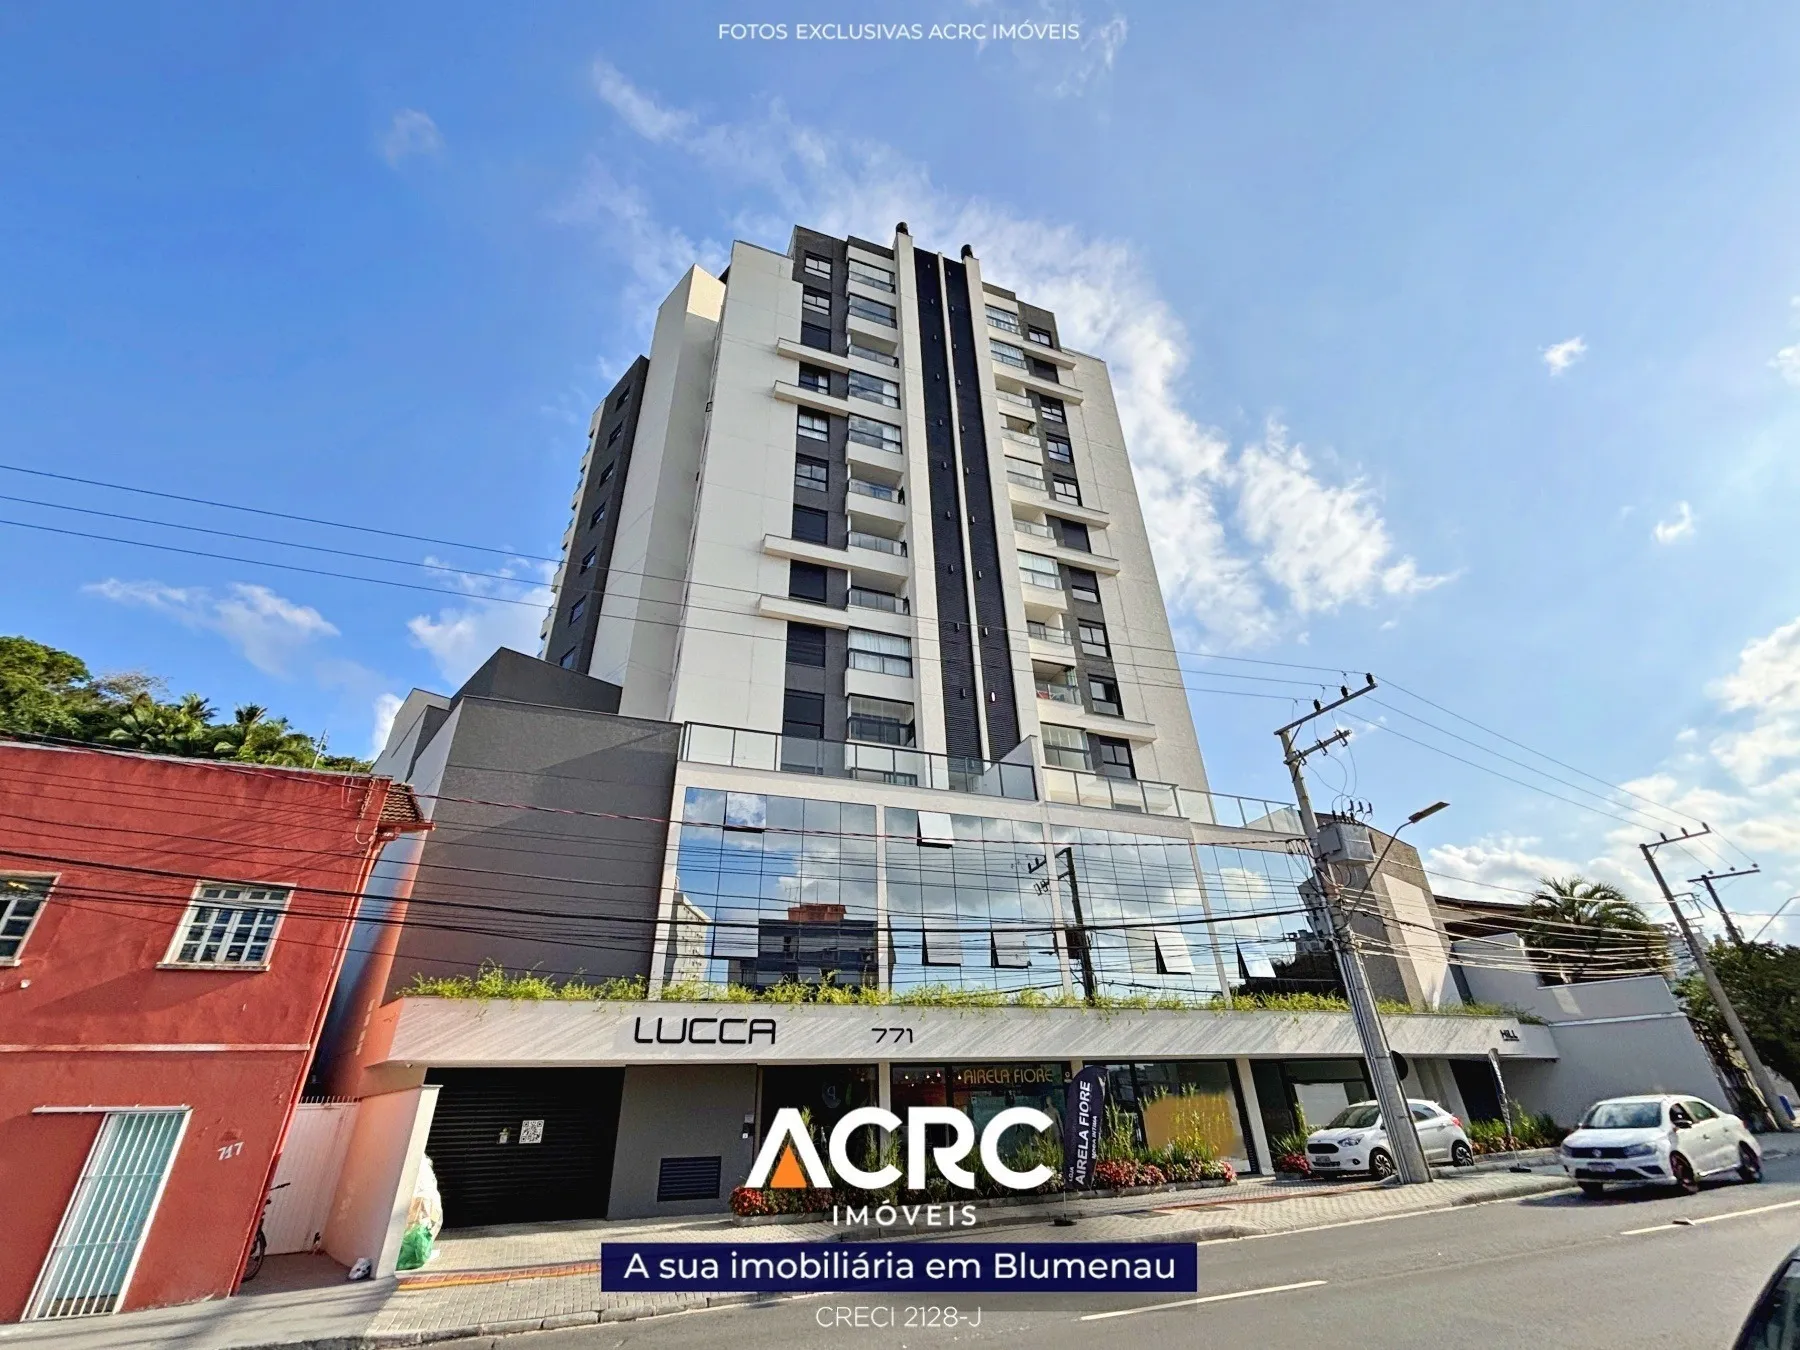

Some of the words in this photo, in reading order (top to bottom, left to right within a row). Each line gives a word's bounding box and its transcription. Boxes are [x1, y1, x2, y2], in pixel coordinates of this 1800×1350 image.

[634, 1016, 777, 1045] LUCCA
[871, 1027, 914, 1044] 771
[963, 1069, 1010, 1084] AIRELA
[1013, 1068, 1054, 1083] FIORE
[1078, 1080, 1092, 1127] FIORE
[1075, 1129, 1090, 1186] AIRELA
